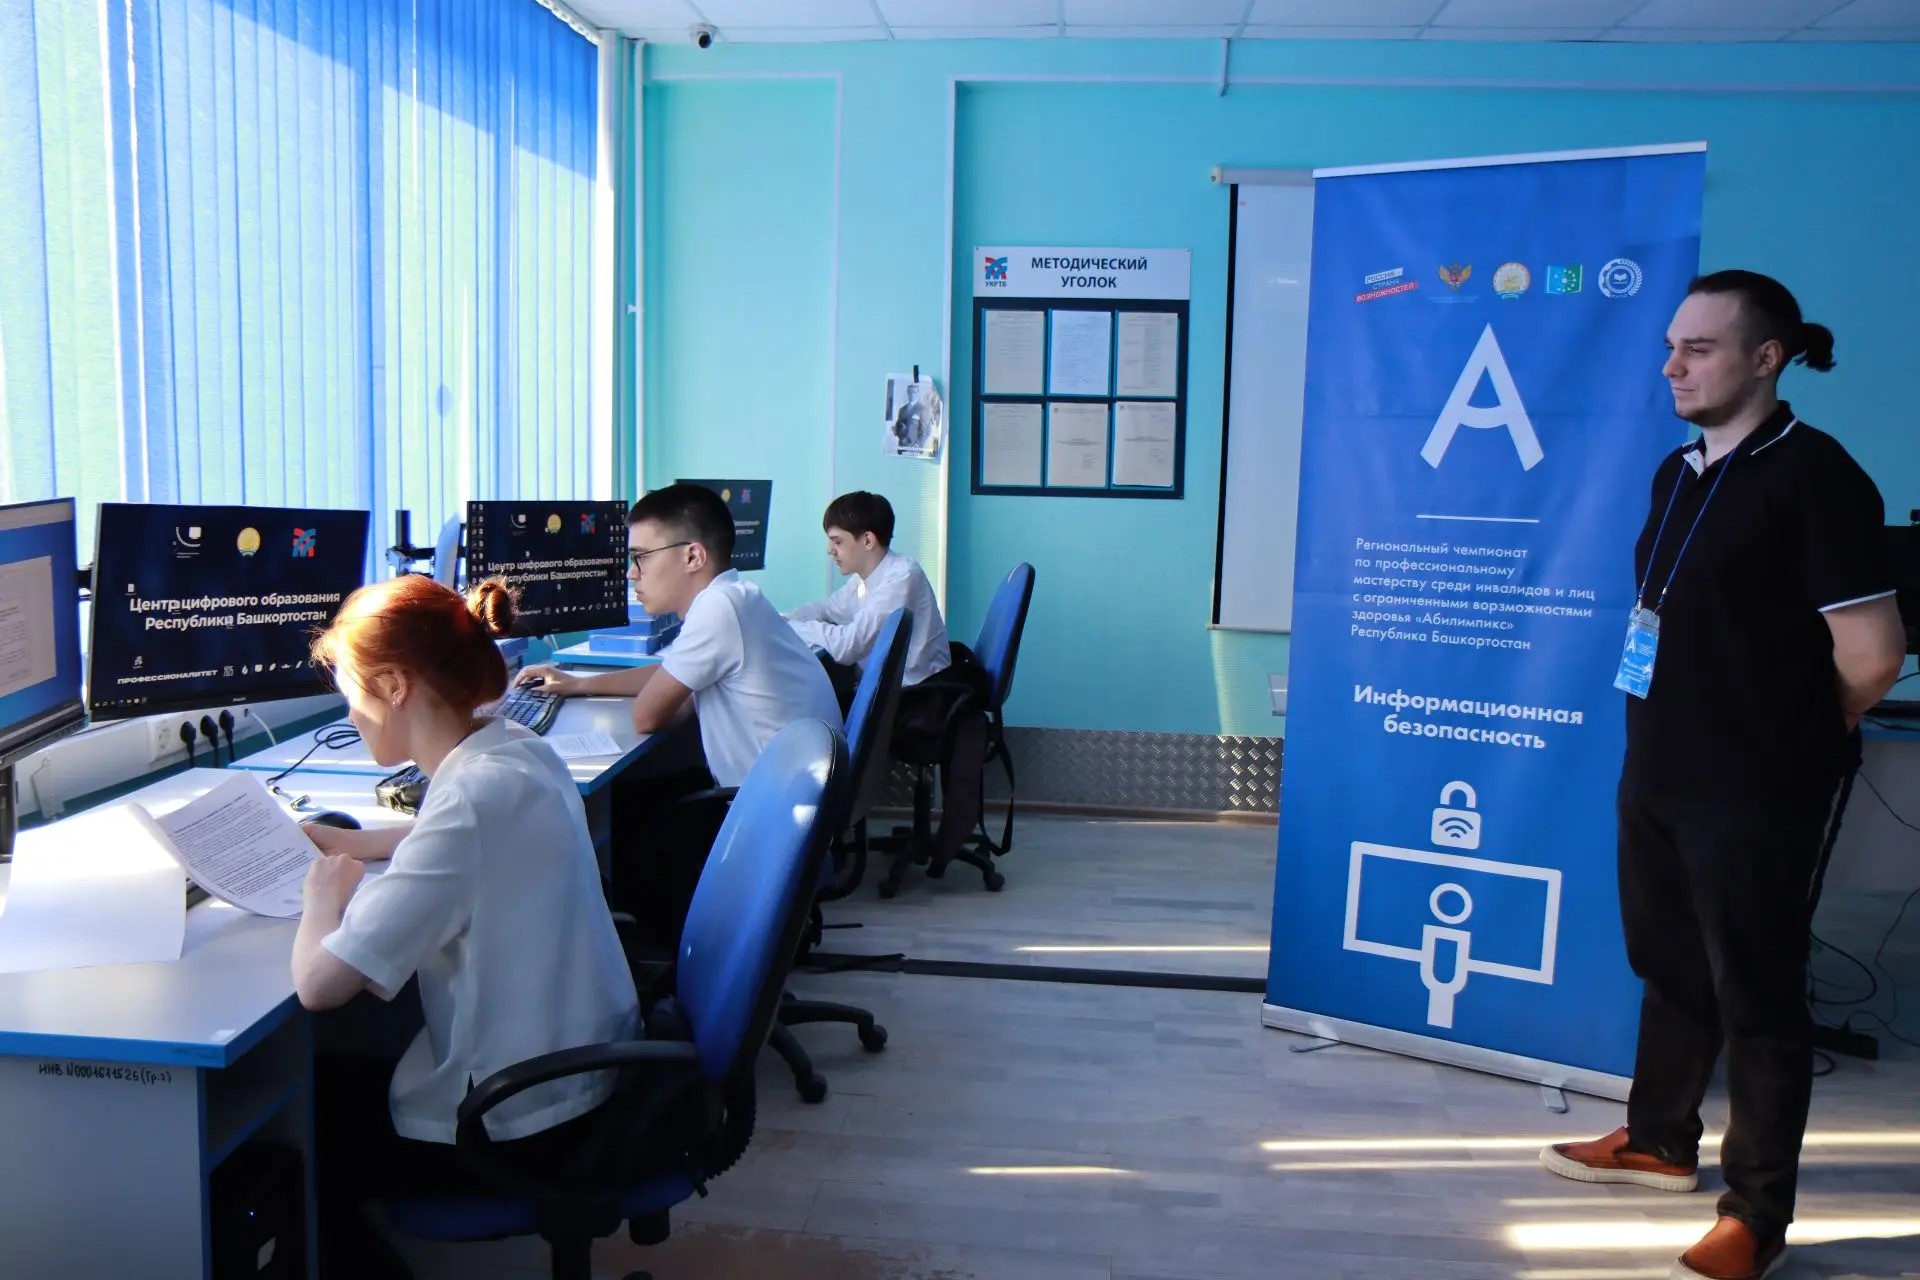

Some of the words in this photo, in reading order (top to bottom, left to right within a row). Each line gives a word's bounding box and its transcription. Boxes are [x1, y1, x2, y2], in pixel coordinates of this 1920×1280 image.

[1031, 256, 1148, 272] МЕТОДИЧЕСКИЙ
[1061, 276, 1117, 288] УГОЛОК
[1372, 279, 1400, 290] СТРАНА
[1356, 538, 1449, 554] Региональный
[1453, 545, 1528, 559] чемпионат
[517, 559, 563, 571] цифрового
[564, 557, 614, 568] образования
[1354, 558, 1371, 568] по
[1375, 557, 1515, 579] профессиональному
[507, 572, 549, 584] спублики
[550, 570, 608, 581] Башкортостан
[1353, 577, 1427, 591] мастерству
[1431, 580, 1471, 593] среди
[1475, 584, 1551, 597] инвалидов
[1555, 588, 1564, 597] и
[1568, 589, 1596, 601] лиц
[129, 597, 181, 613] Центр
[181, 594, 259, 611] цифрового
[260, 592, 341, 609] образования
[1352, 593, 1360, 602] с
[1363, 594, 1468, 609] ограниченными
[1472, 601, 1593, 618] ворзможностями
[236, 609, 327, 626] Башкортостан
[1351, 610, 1411, 624] здоровья
[1415, 611, 1514, 630] «Абилимпикс»
[1351, 624, 1427, 642] Республика
[1431, 630, 1531, 650] Башкортостан
[117, 669, 218, 685] ПРОФЕССИОНАЛИТЕТ
[1353, 684, 1584, 725] Информационная
[1383, 713, 1547, 750] безопасность
